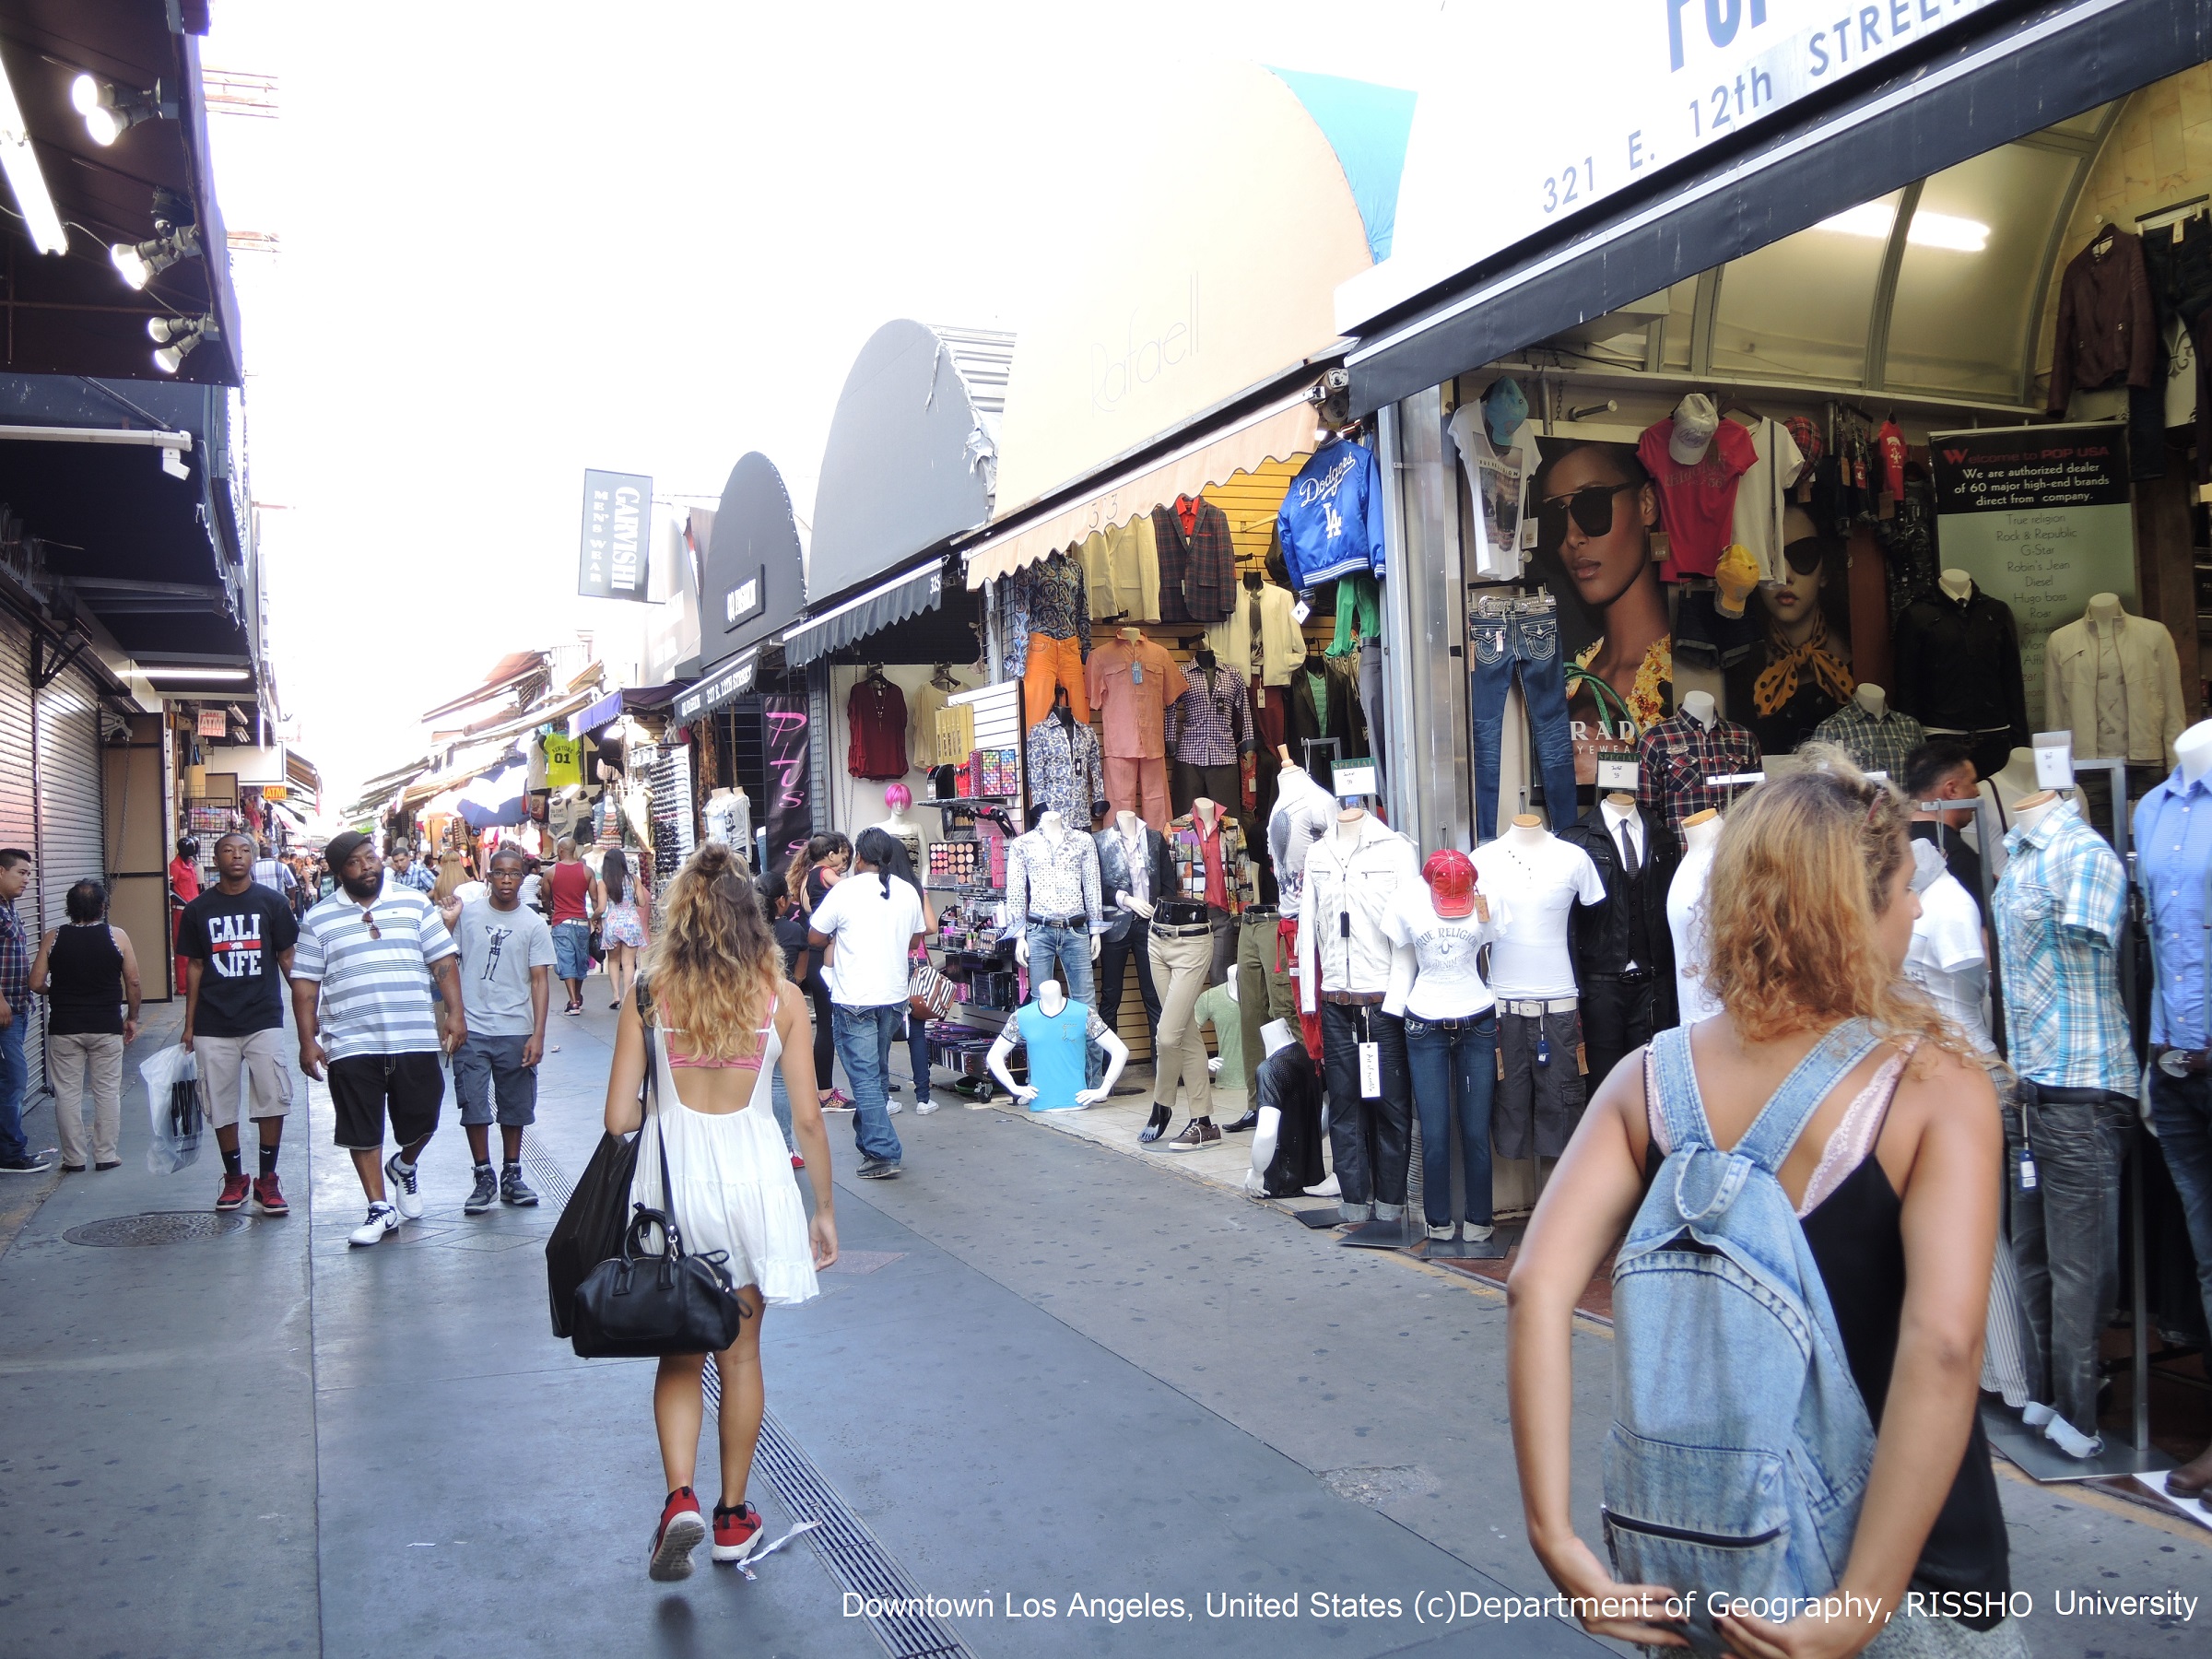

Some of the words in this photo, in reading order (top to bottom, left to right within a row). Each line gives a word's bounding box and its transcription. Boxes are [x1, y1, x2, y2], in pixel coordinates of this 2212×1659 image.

[1543, 156, 1594, 214] 321
[1628, 129, 1655, 171] E.
[1688, 65, 1772, 137] 12th
[1943, 448, 2019, 465] Welcome
[2024, 452, 2037, 461] to
[2041, 448, 2074, 458] POP
[2077, 446, 2110, 457] USA
[1962, 468, 1983, 478] We
[1987, 470, 2005, 478] are
[2008, 463, 2064, 477] authorized
[2066, 462, 2100, 474] dealer
[1300, 451, 1356, 508] Dodgers
[1954, 483, 1966, 494] of
[1970, 482, 1987, 493] 60
[1991, 482, 2020, 492] major
[2024, 476, 2071, 491] high-end
[2074, 475, 2110, 487] brands
[1976, 495, 2007, 506] direct
[2010, 493, 2034, 503] from
[2042, 493, 2094, 503] company.
[1323, 502, 1342, 539] LA
[2006, 513, 2029, 524] True
[2031, 512, 2065, 524] religion
[1996, 530, 2020, 541] Rock
[2024, 531, 2031, 540] &
[2035, 526, 2078, 540] Republic
[2020, 544, 2054, 556] G-Star
[2007, 559, 2042, 571] Robin's
[2046, 559, 2070, 571] Jean
[929, 573, 941, 594] 325
[2025, 574, 2053, 587] Diesel
[2014, 593, 2041, 605] Hugo
[2044, 591, 2067, 602] boss
[2030, 607, 2052, 618] Roar
[201, 716, 223, 729] ATM
[554, 752, 571, 764] 01
[1598, 753, 1638, 762] SPECIAL
[1333, 759, 1372, 770] SPECIAL
[265, 786, 285, 798] ATM
[208, 913, 261, 944] CALI
[1438, 927, 1478, 948] RELIGION
